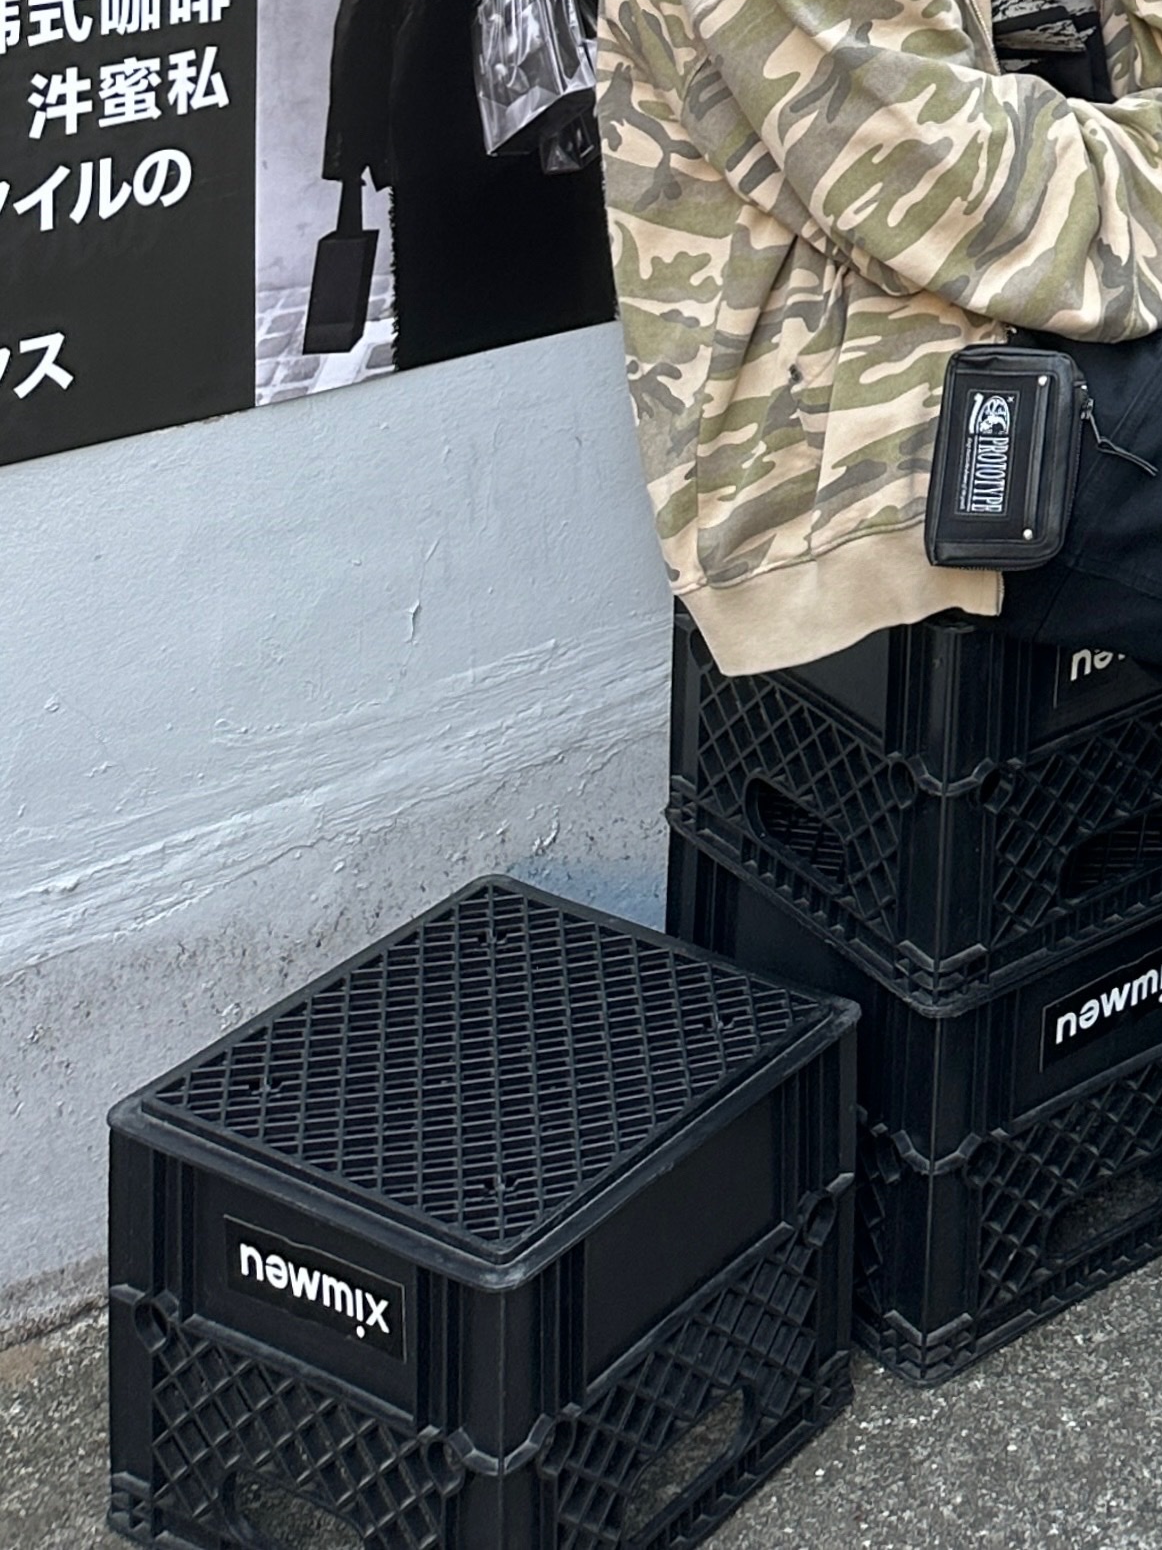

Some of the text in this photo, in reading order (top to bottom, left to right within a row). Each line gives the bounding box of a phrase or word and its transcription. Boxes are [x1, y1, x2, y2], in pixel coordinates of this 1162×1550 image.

[0, 148, 193, 232] イルの
[0, 332, 75, 400] ス
[971, 436, 1010, 512] PROTOTYPE
